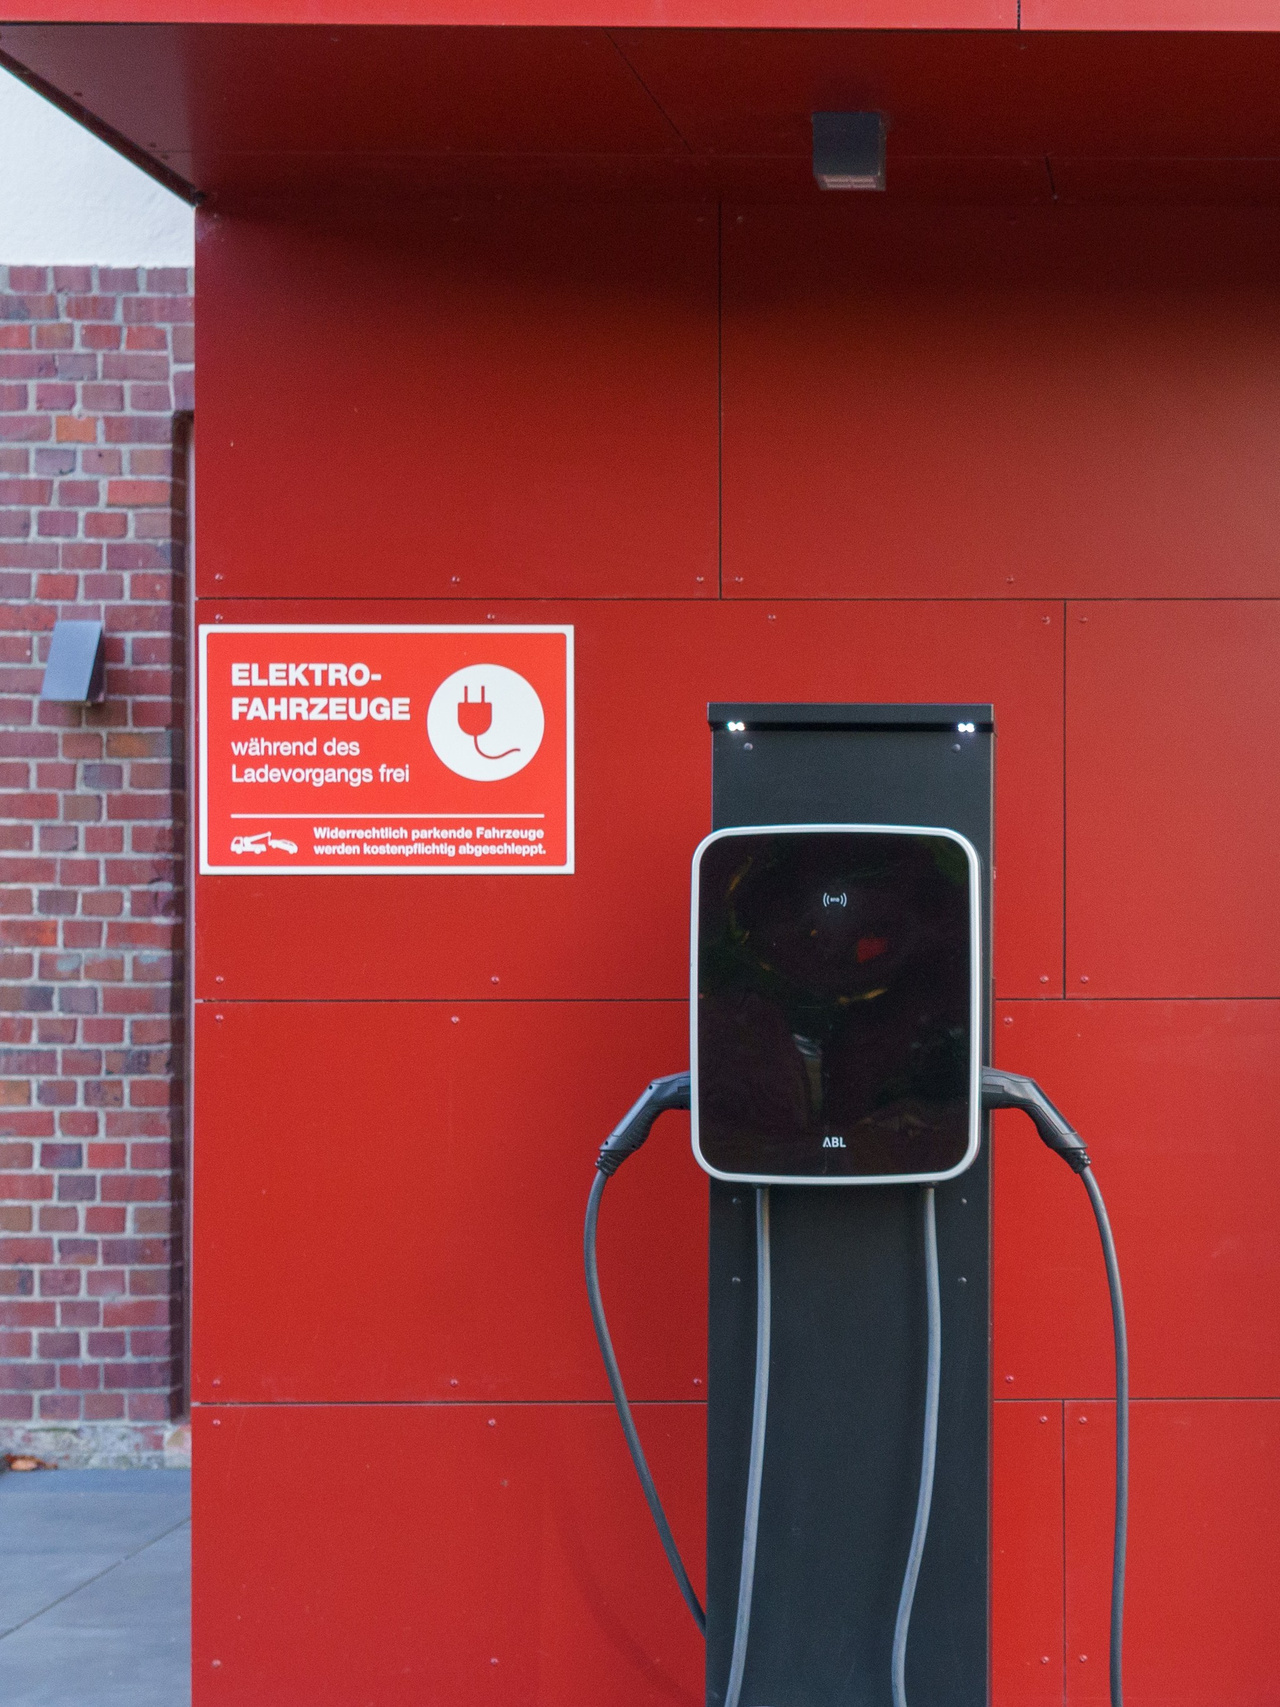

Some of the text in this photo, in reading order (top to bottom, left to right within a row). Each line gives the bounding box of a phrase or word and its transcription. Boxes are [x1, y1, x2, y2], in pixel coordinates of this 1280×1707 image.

[231, 663, 382, 687] ELEKTRO-
[231, 697, 411, 721] FAHRZEUGE
[231, 737, 360, 756] während des
[231, 763, 410, 787] Ladevorgangs frei
[313, 826, 544, 841] Widerrechtlich parkende Fahrzeuge
[313, 842, 547, 857] werden kostenpflichtig abgeschleppt.
[822, 1136, 847, 1148] ABL
